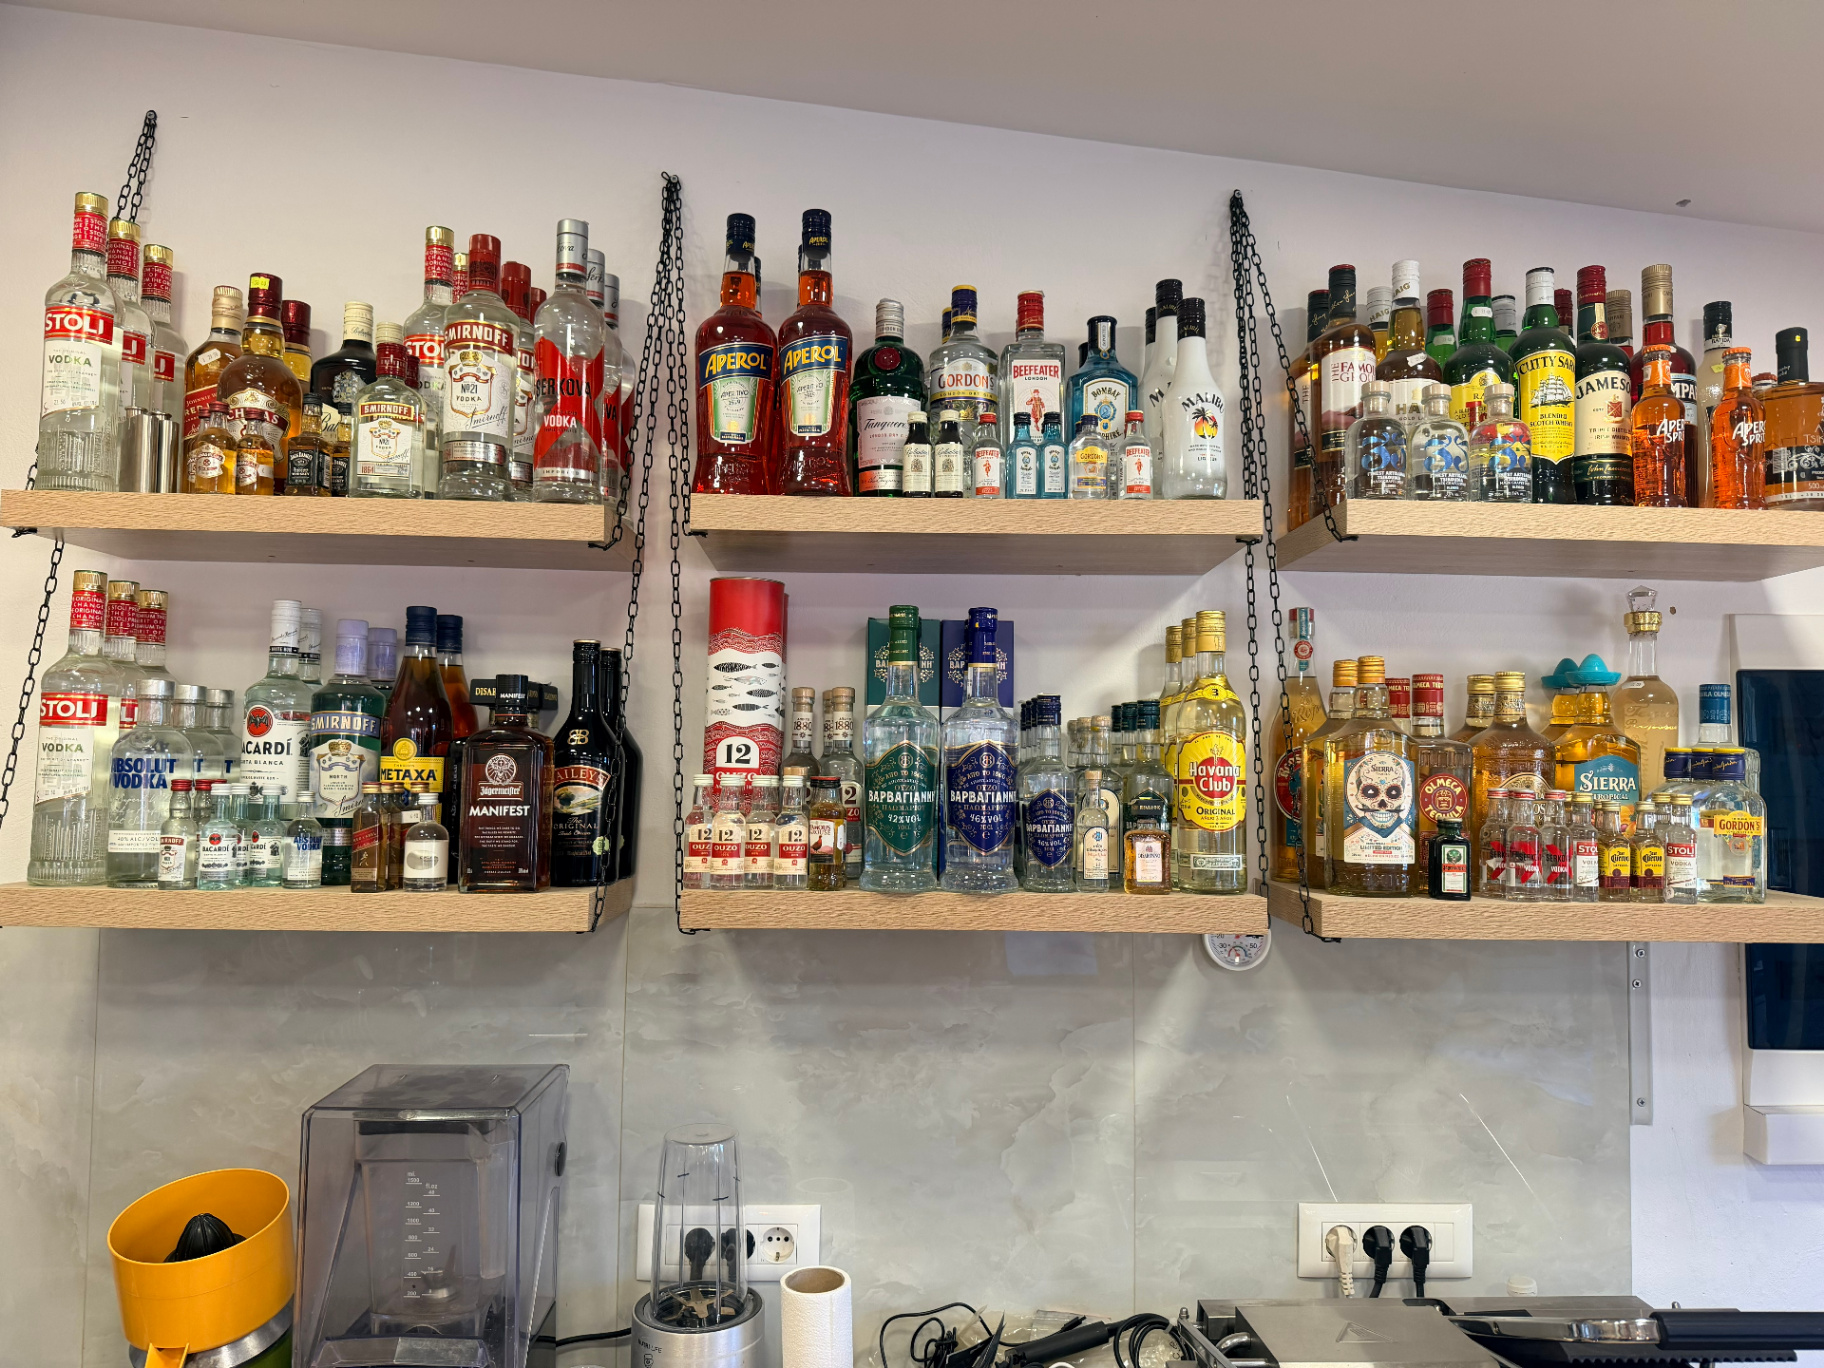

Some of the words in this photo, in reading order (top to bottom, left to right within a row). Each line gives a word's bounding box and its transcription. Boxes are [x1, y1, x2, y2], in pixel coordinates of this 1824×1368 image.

[1369, 309, 1389, 322] HAIG
[46, 314, 103, 335] STOLI
[444, 324, 508, 348] SMIRNOFF
[48, 354, 92, 367] VODKA
[705, 352, 767, 378] APEROL
[784, 345, 842, 374] APEROL
[1519, 356, 1556, 375] CUTTY
[1014, 364, 1059, 379] BEEFEATER
[536, 377, 591, 400] SERKOVA
[938, 374, 994, 390] GORDON'S
[1576, 377, 1632, 400] JAMESO
[1091, 387, 1121, 400] BOMBAY
[364, 404, 408, 415] SMIRNOFF
[1182, 392, 1225, 413] MALIBU
[185, 406, 202, 416] RED
[228, 409, 278, 424] CHAS
[544, 414, 577, 428] VODKA
[1126, 448, 1150, 457] BEEFEATER
[40, 700, 97, 718] STOLI
[311, 715, 374, 732] SMIRNOFF
[835, 721, 853, 730] 1880
[42, 743, 83, 753] VODKA
[242, 739, 291, 755] ACARDÍ
[725, 744, 751, 764] 12
[111, 758, 177, 774] ABSOLUT
[1189, 762, 1241, 776] Havana
[1371, 764, 1394, 772] SIERRA
[113, 774, 167, 789] VODKA
[381, 769, 437, 781] METAXA
[556, 768, 607, 787] AILEYS
[1580, 770, 1636, 792] SIERRA
[1200, 777, 1231, 792] Club
[1425, 778, 1462, 795] OLMECA
[469, 805, 530, 816] MANIFEST
[1196, 807, 1235, 815] ORIGINAL
[1719, 819, 1760, 831] GORDON'S
[719, 829, 733, 841] 12
[749, 829, 762, 840] 12
[788, 830, 802, 842] 12
[202, 844, 229, 852] BACARDÍ
[1667, 846, 1695, 855] STOLI
[1611, 855, 1629, 863] Cuervo
[1642, 854, 1662, 863] Cuervo
